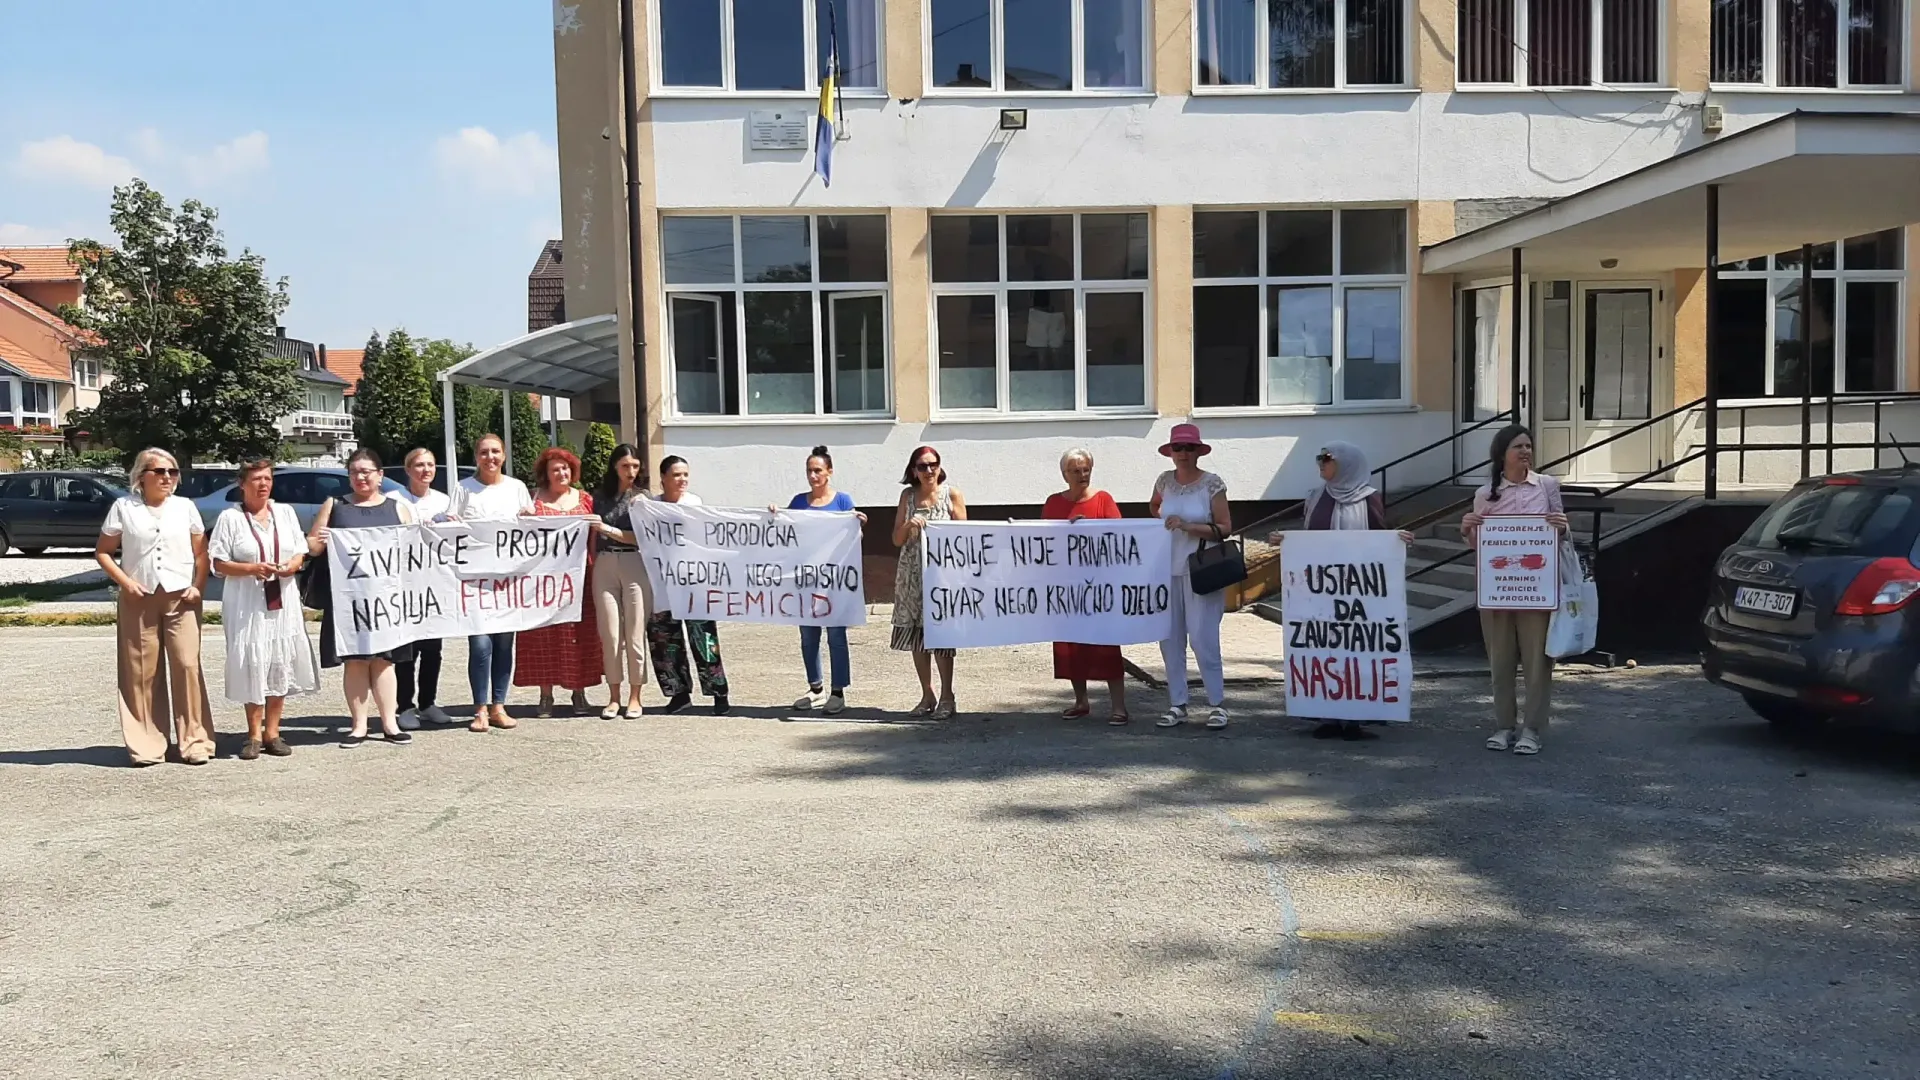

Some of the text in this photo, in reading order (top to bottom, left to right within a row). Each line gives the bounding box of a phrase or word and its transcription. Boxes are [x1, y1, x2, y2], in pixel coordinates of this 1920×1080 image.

[642, 519, 799, 548] NIJE PORODIČNA
[347, 527, 580, 579] ŽIVINICE PROTIV
[926, 531, 1142, 577] NASILJE NIJE PRIVATNA
[746, 563, 782, 588] NEGO
[794, 562, 859, 592] UBISTVO
[1306, 561, 1388, 598] USTANI
[352, 572, 575, 632] NASILJA FEMICIDA
[687, 589, 833, 619] I FEMICID
[930, 576, 1169, 621] STVAR NEGO KRIVIČNO DJELO
[1334, 598, 1368, 622] DA
[1740, 589, 1793, 612] K47-T-307
[1289, 617, 1402, 653] ZAUSTAVIŠ
[1289, 653, 1399, 703] NASILJE
